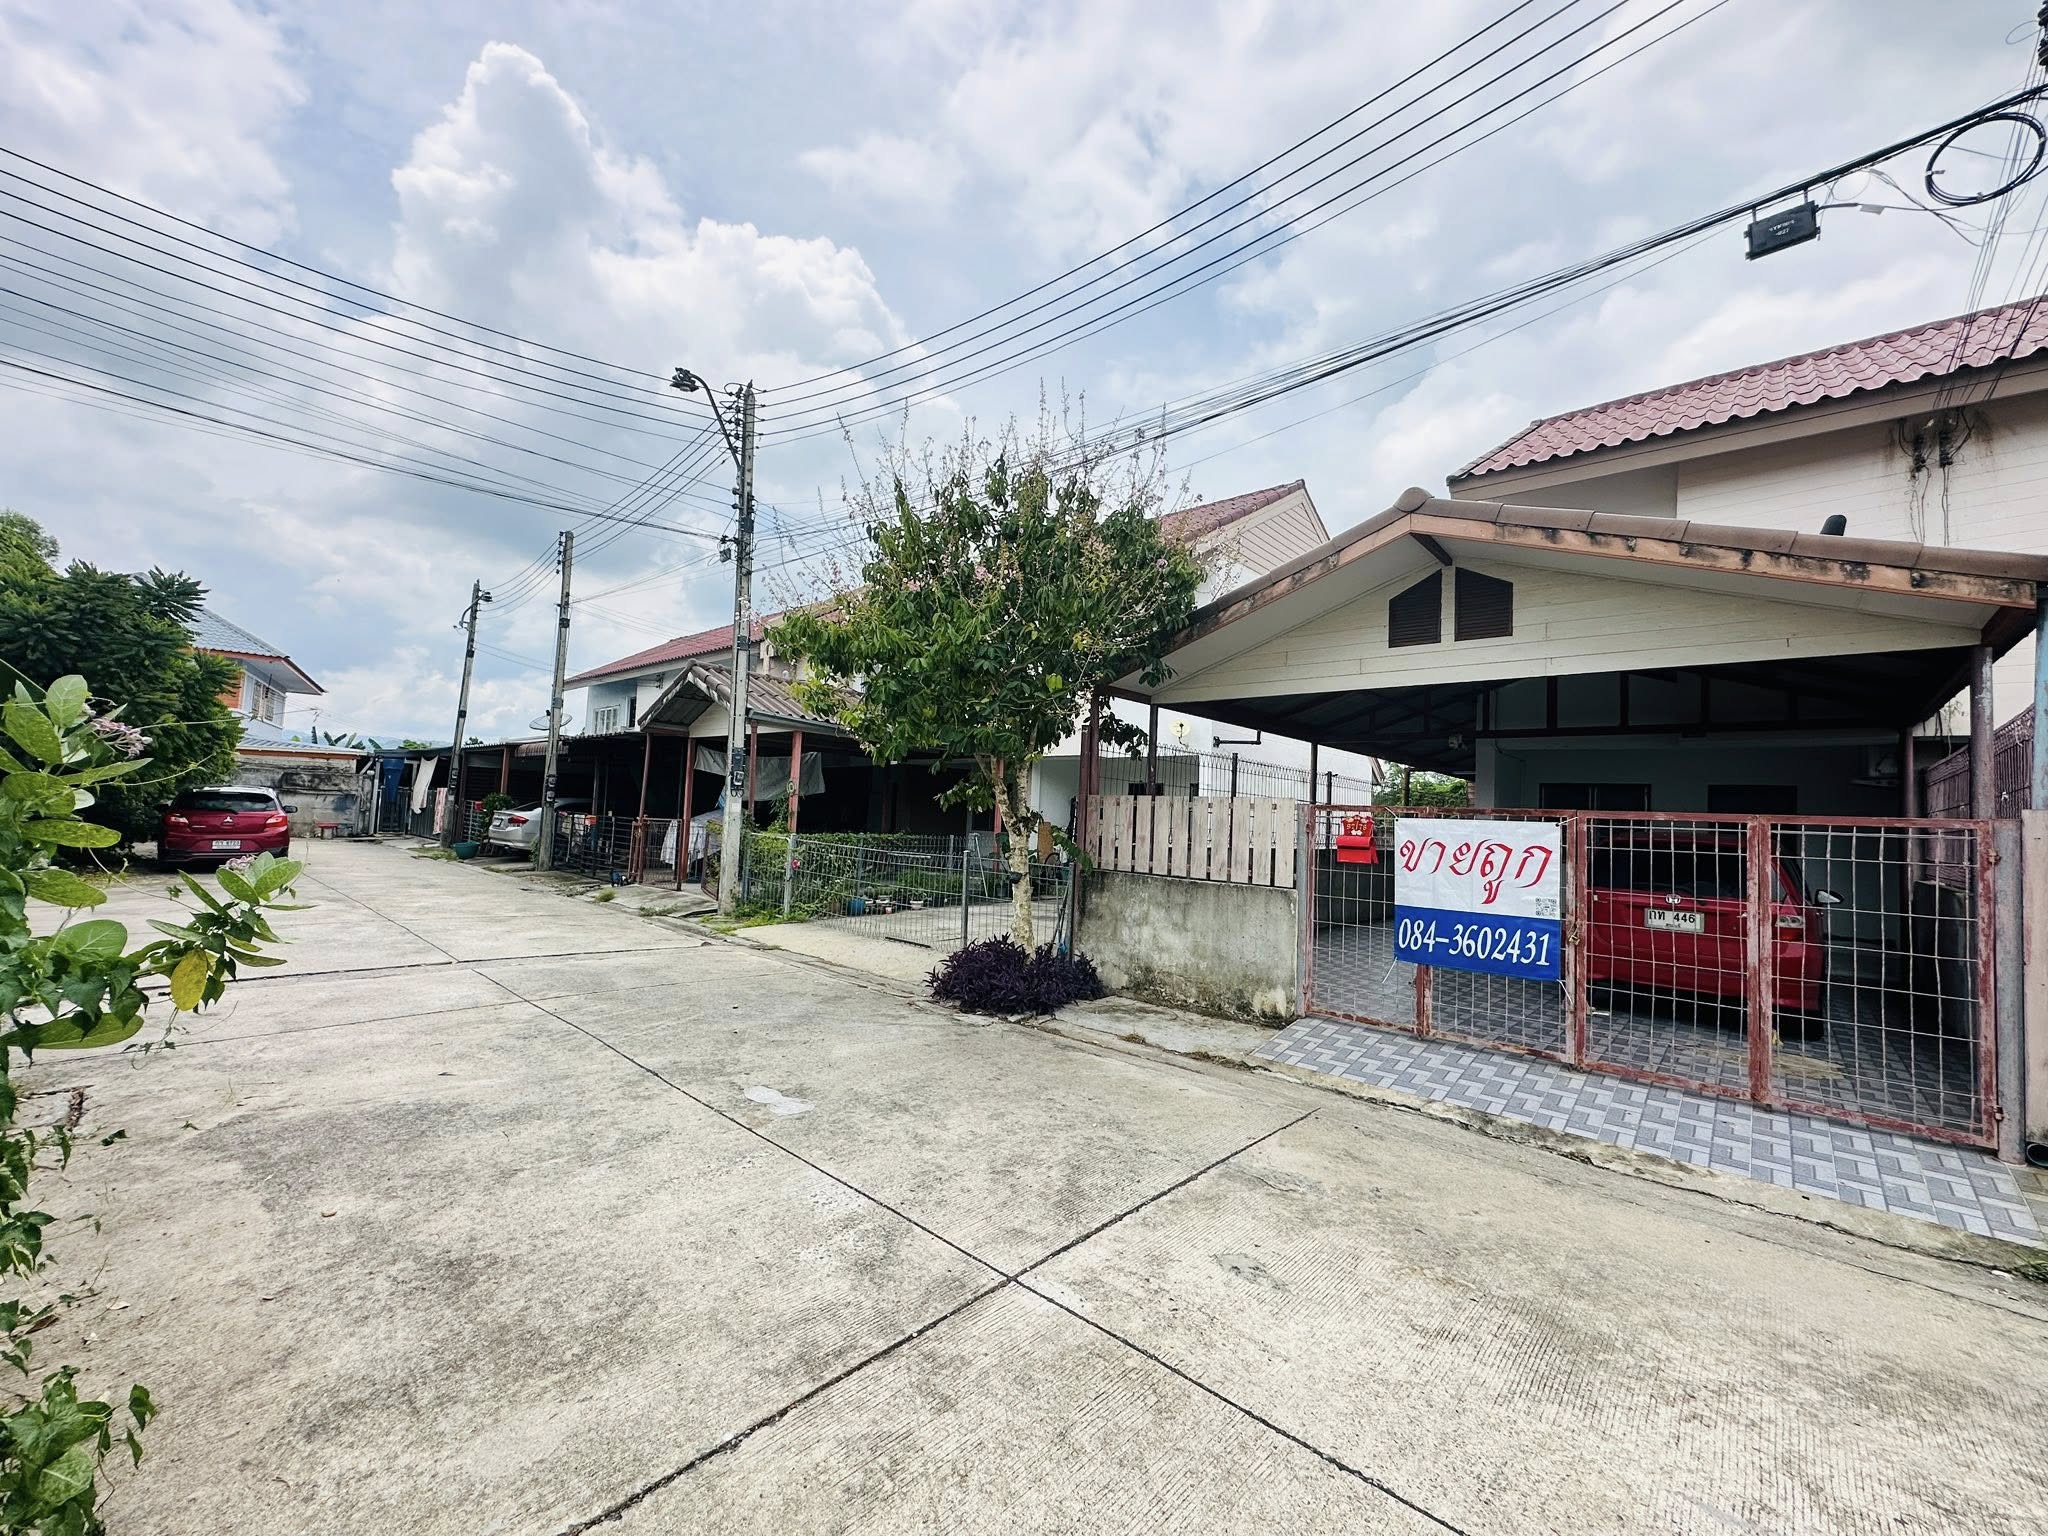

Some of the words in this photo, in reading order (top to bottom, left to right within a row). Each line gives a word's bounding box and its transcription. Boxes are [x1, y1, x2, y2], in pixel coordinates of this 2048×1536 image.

[1399, 837, 1553, 905] ขายถูก
[1398, 918, 1551, 966] 084-3602431
[1673, 912, 1696, 924] 446
